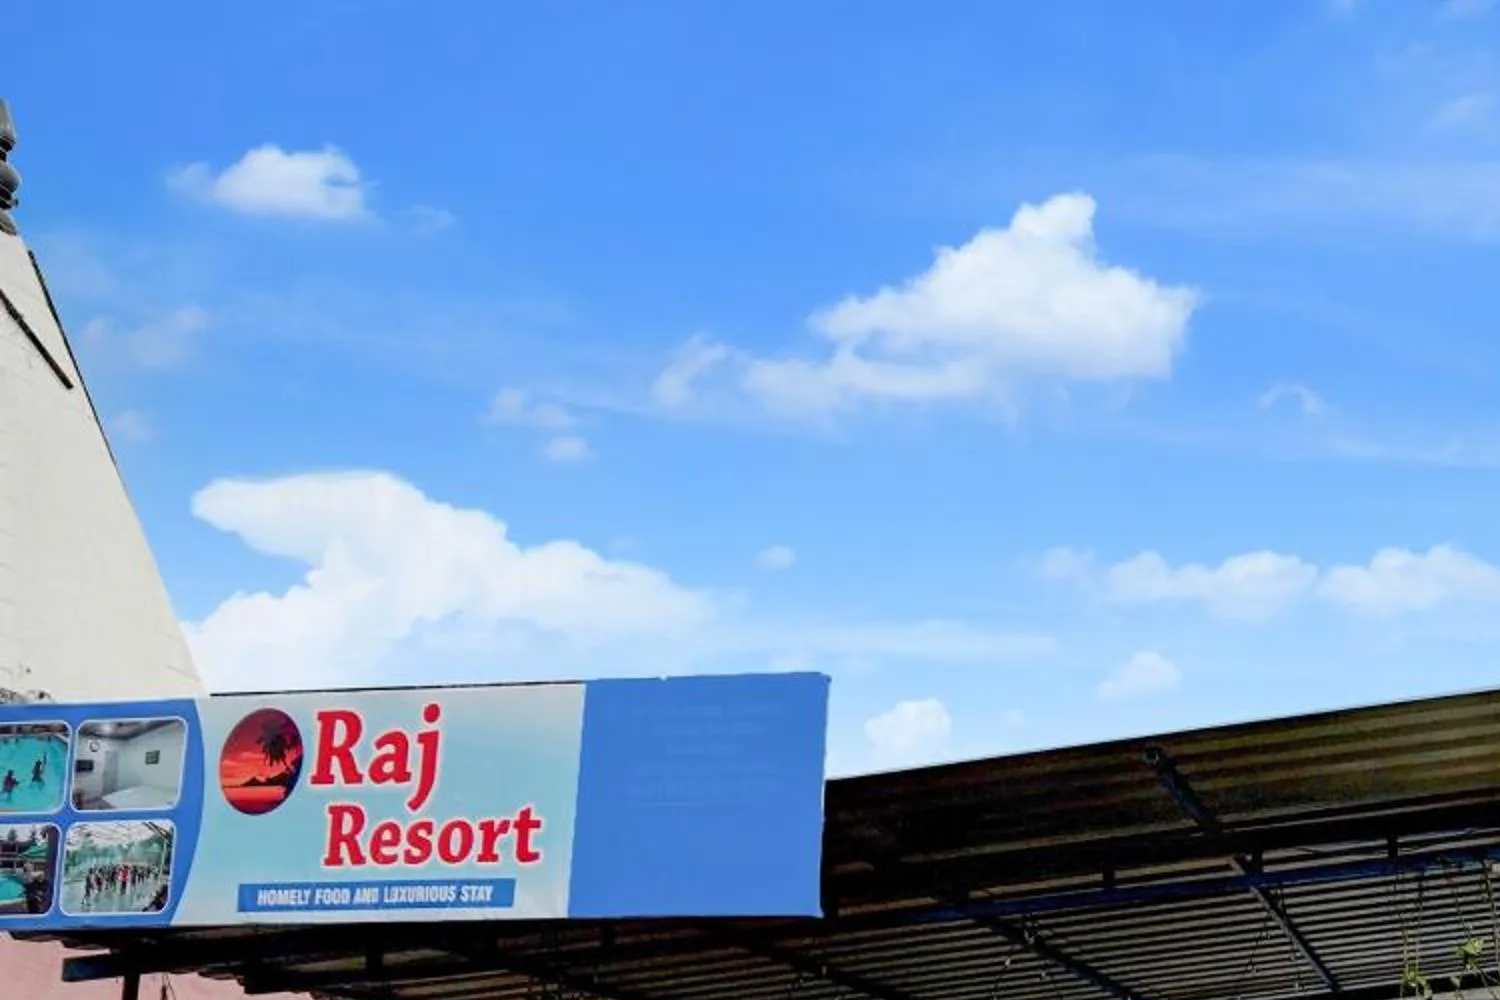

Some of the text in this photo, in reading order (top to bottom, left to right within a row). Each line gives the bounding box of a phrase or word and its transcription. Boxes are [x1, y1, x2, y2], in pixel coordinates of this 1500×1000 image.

[310, 703, 441, 812] Raj
[324, 805, 541, 866] Resort
[257, 889, 310, 906] HOMELY
[315, 888, 350, 905] FOOD
[352, 887, 379, 904] AND
[459, 885, 494, 902] STAY
